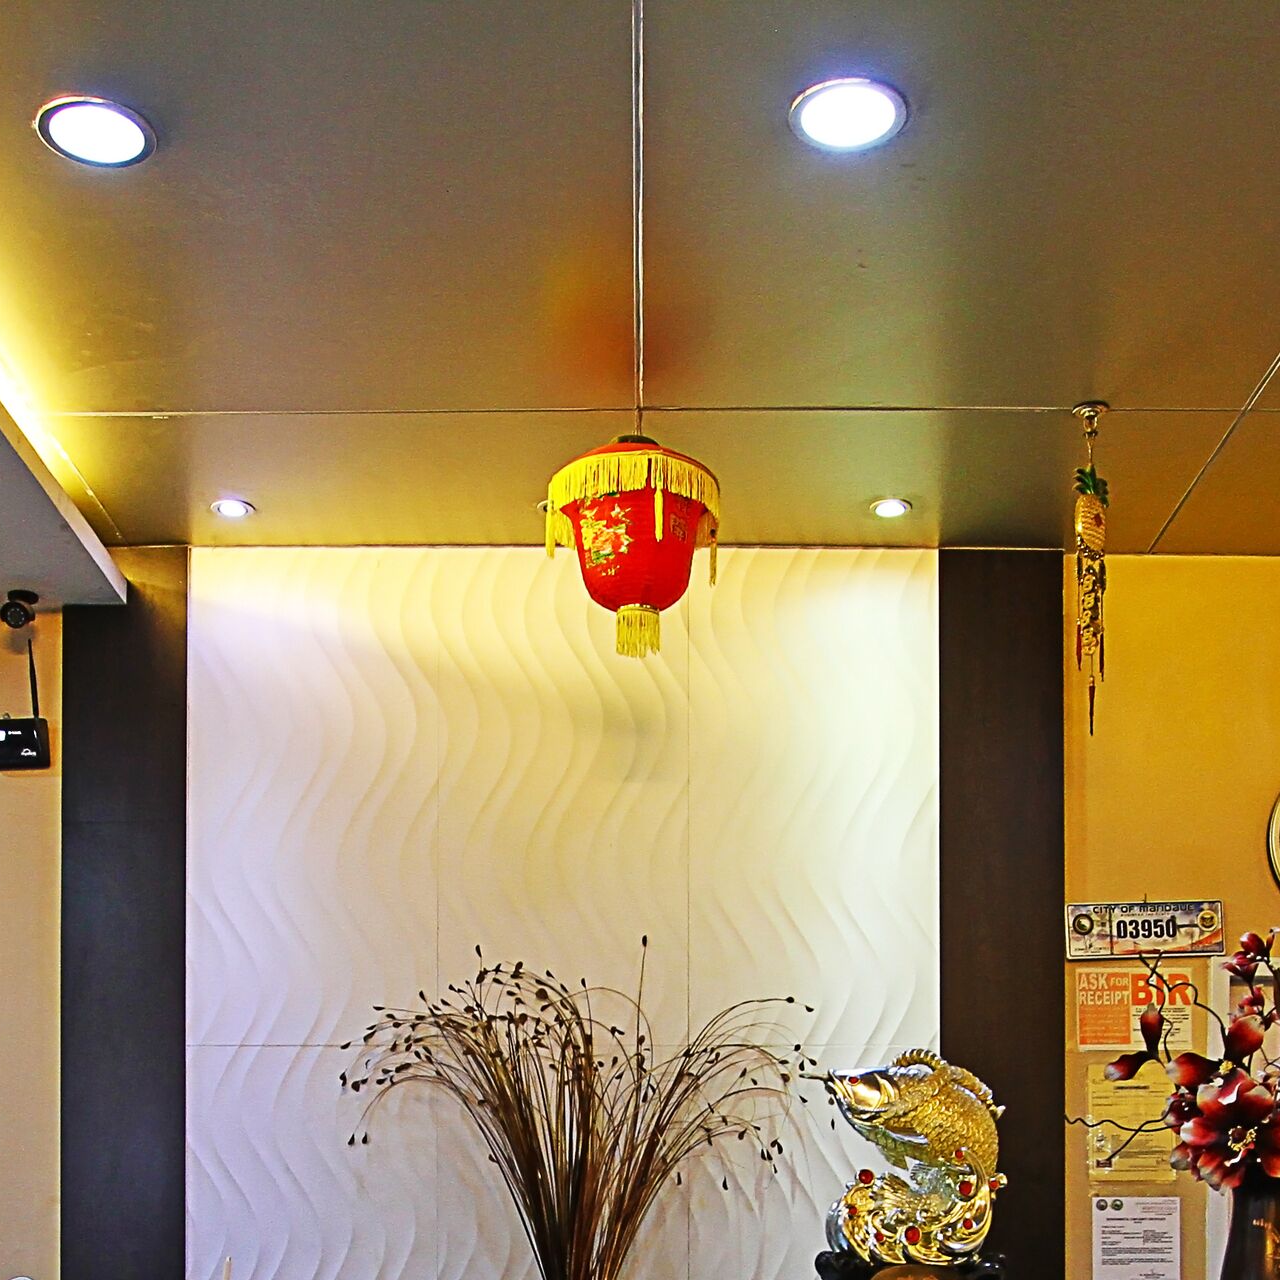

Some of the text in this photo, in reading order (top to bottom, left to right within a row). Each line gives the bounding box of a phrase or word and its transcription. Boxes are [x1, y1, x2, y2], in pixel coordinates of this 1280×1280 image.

[1093, 905, 1117, 914] CITY
[1120, 905, 1133, 913] OF
[1116, 918, 1178, 939] 03950
[1079, 991, 1129, 1005] RECEIPT
[1080, 973, 1191, 1006] ASK FOR BIR
